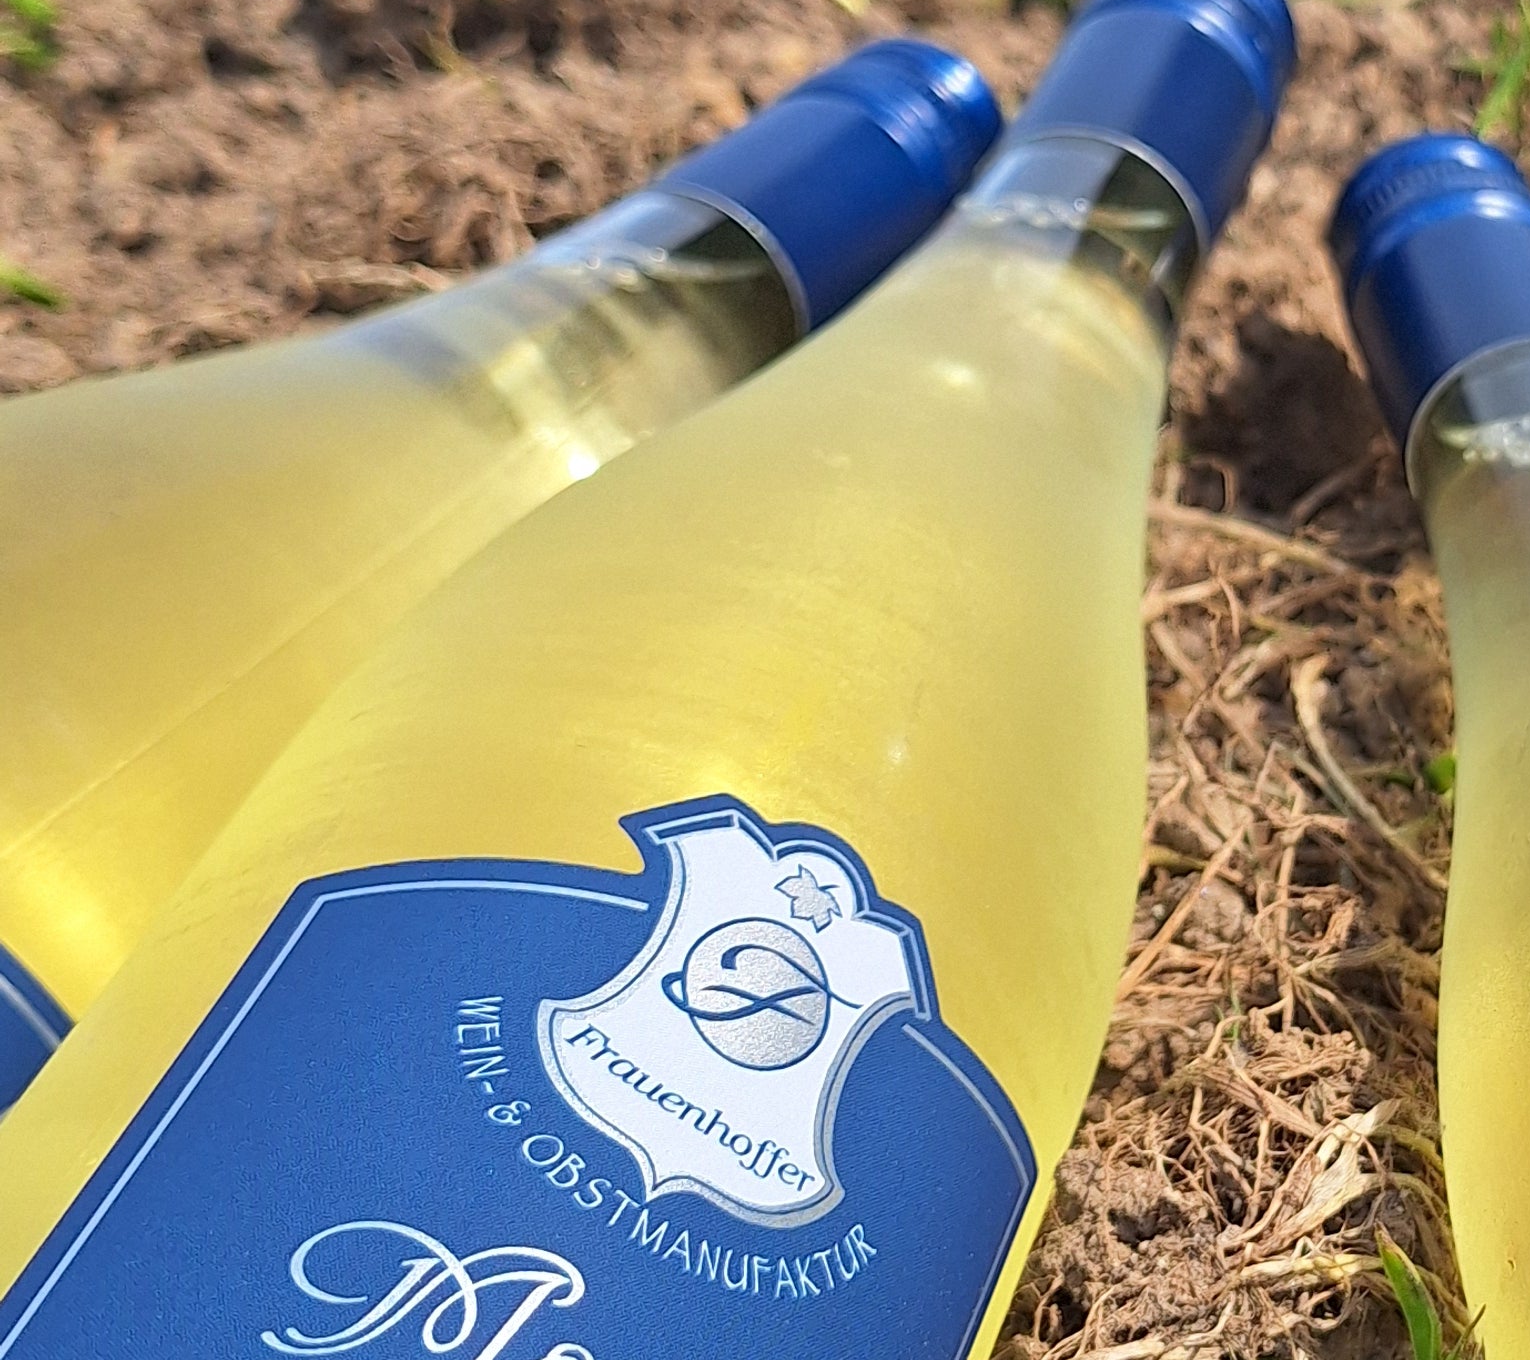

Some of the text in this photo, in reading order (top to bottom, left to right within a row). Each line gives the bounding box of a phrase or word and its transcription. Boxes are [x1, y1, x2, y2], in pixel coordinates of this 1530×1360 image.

[456, 995, 879, 1300] WEIN- & OBSTMANUFAKTUR
[565, 1022, 818, 1193] Frauenhoffer
